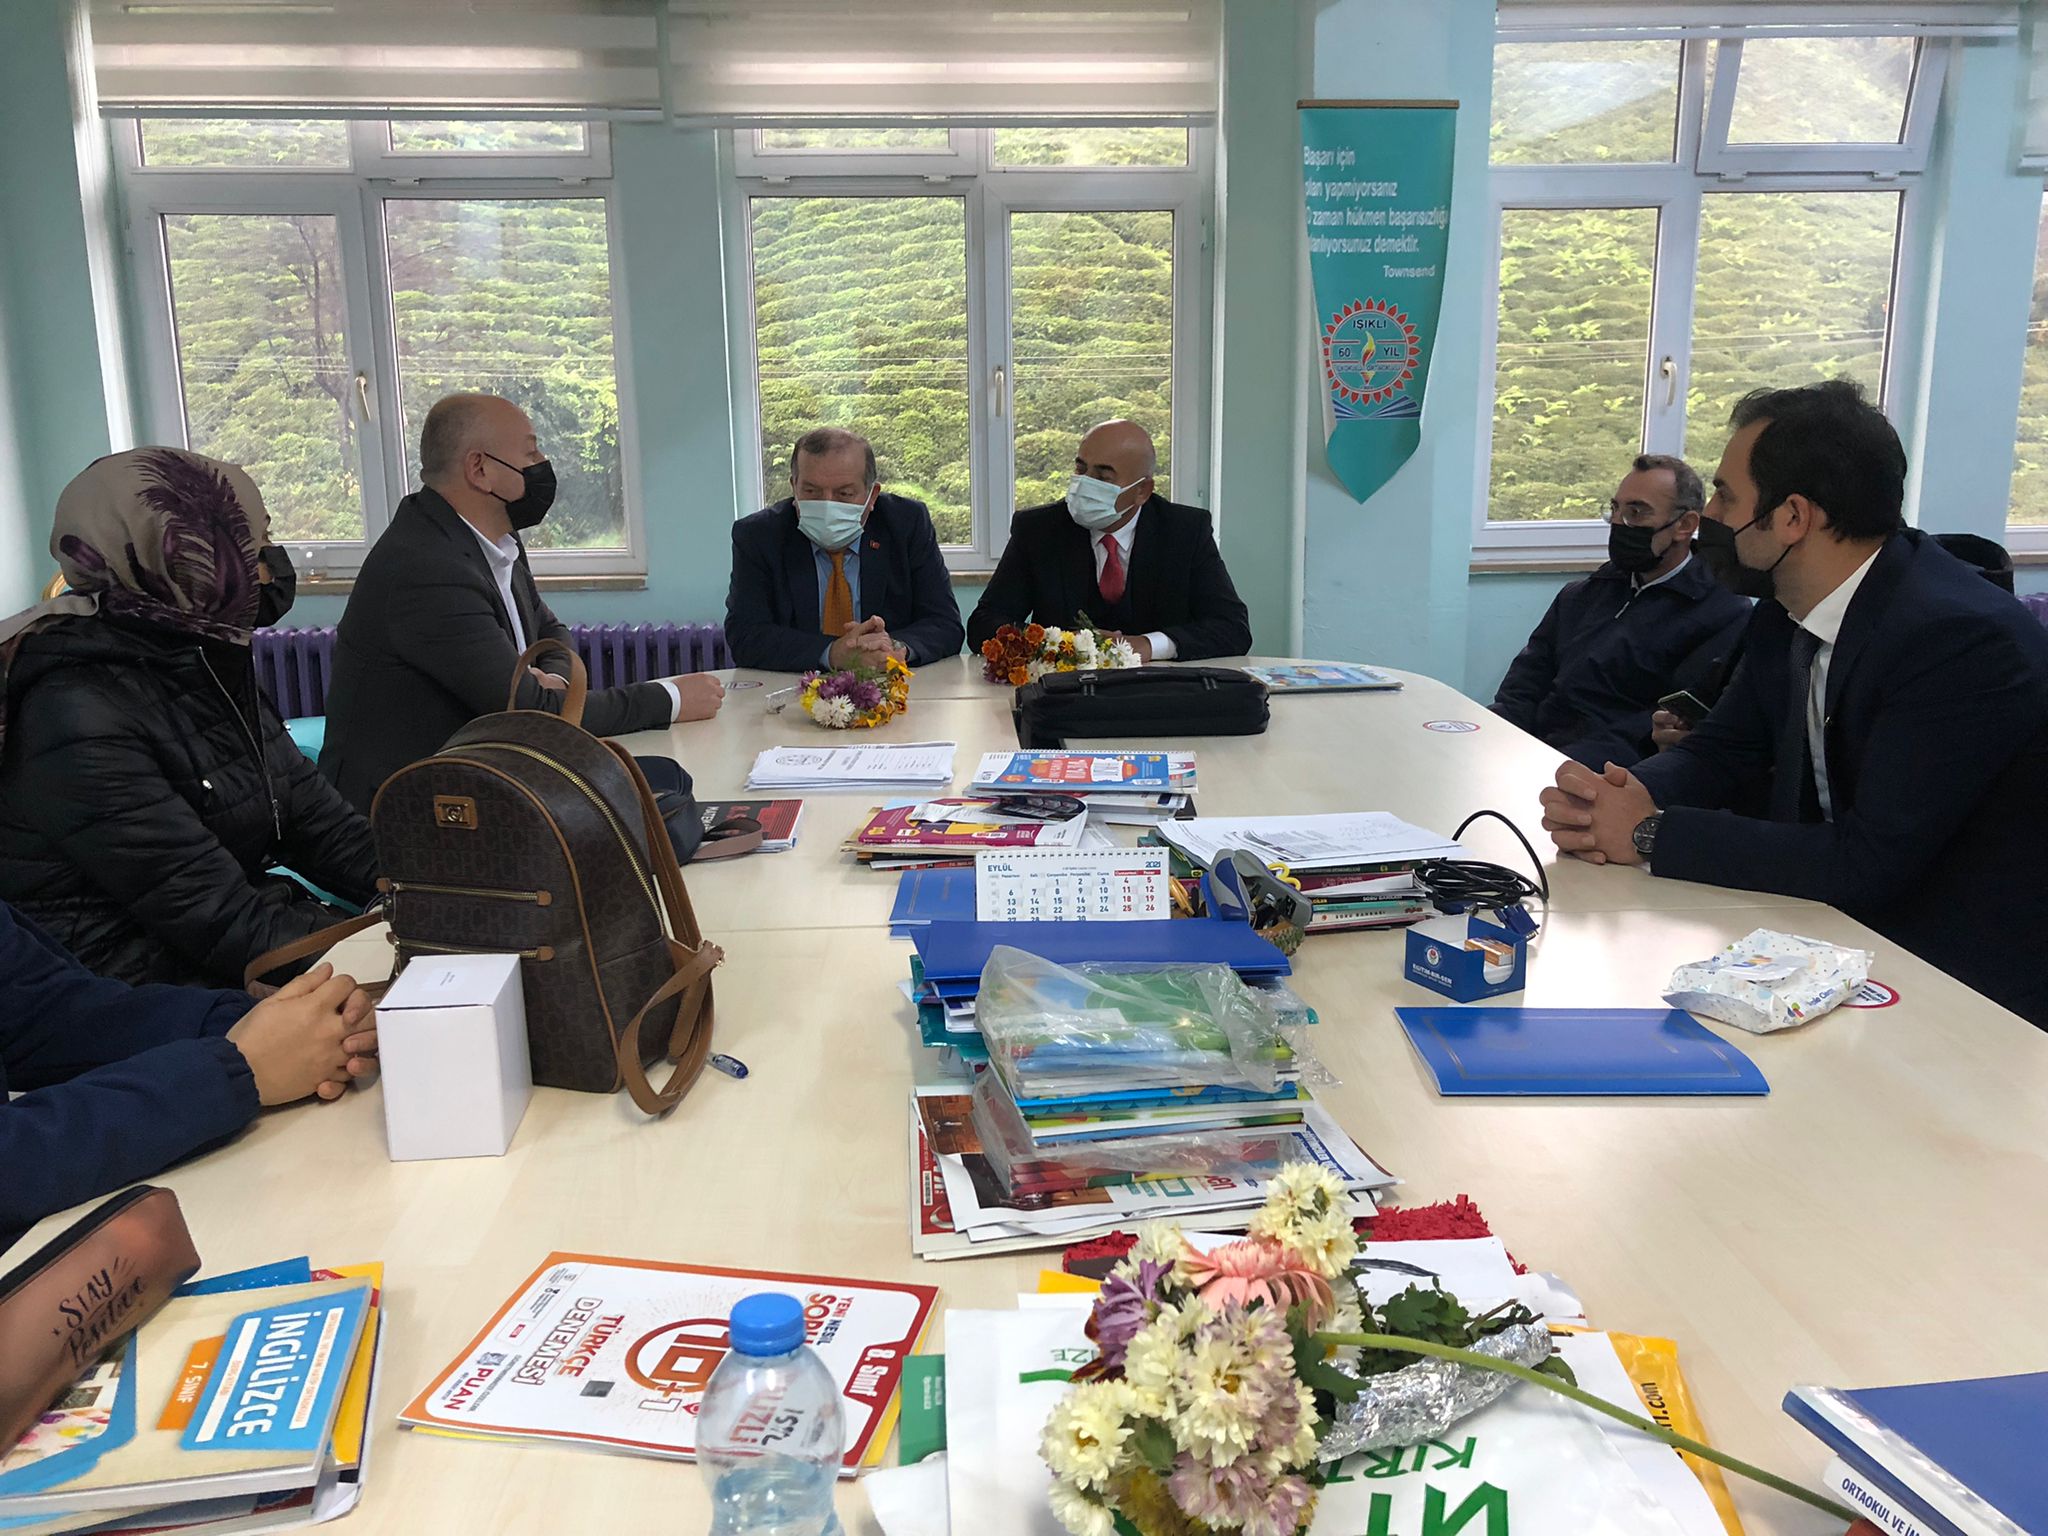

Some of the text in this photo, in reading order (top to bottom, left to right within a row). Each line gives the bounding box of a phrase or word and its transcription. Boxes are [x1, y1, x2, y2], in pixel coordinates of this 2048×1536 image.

[1336, 147, 1355, 171] için
[1313, 210, 1343, 226] zaman
[1383, 264, 1435, 278] Townsend
[1353, 319, 1387, 330] IŞIKLI
[1383, 347, 1400, 357] YIL
[987, 862, 1013, 872] EYLÜL
[59, 1268, 113, 1328] STAY
[511, 1297, 603, 1386] DENEMESİ
[557, 1315, 625, 1377] TÜRKÇE
[226, 1311, 322, 1438] İNGİLİZCE
[176, 1375, 203, 1403] SINIF
[444, 1368, 494, 1410] PUAN
[1842, 1478, 1891, 1523] ORTAOKUL
[1891, 1515, 1906, 1534] VE
